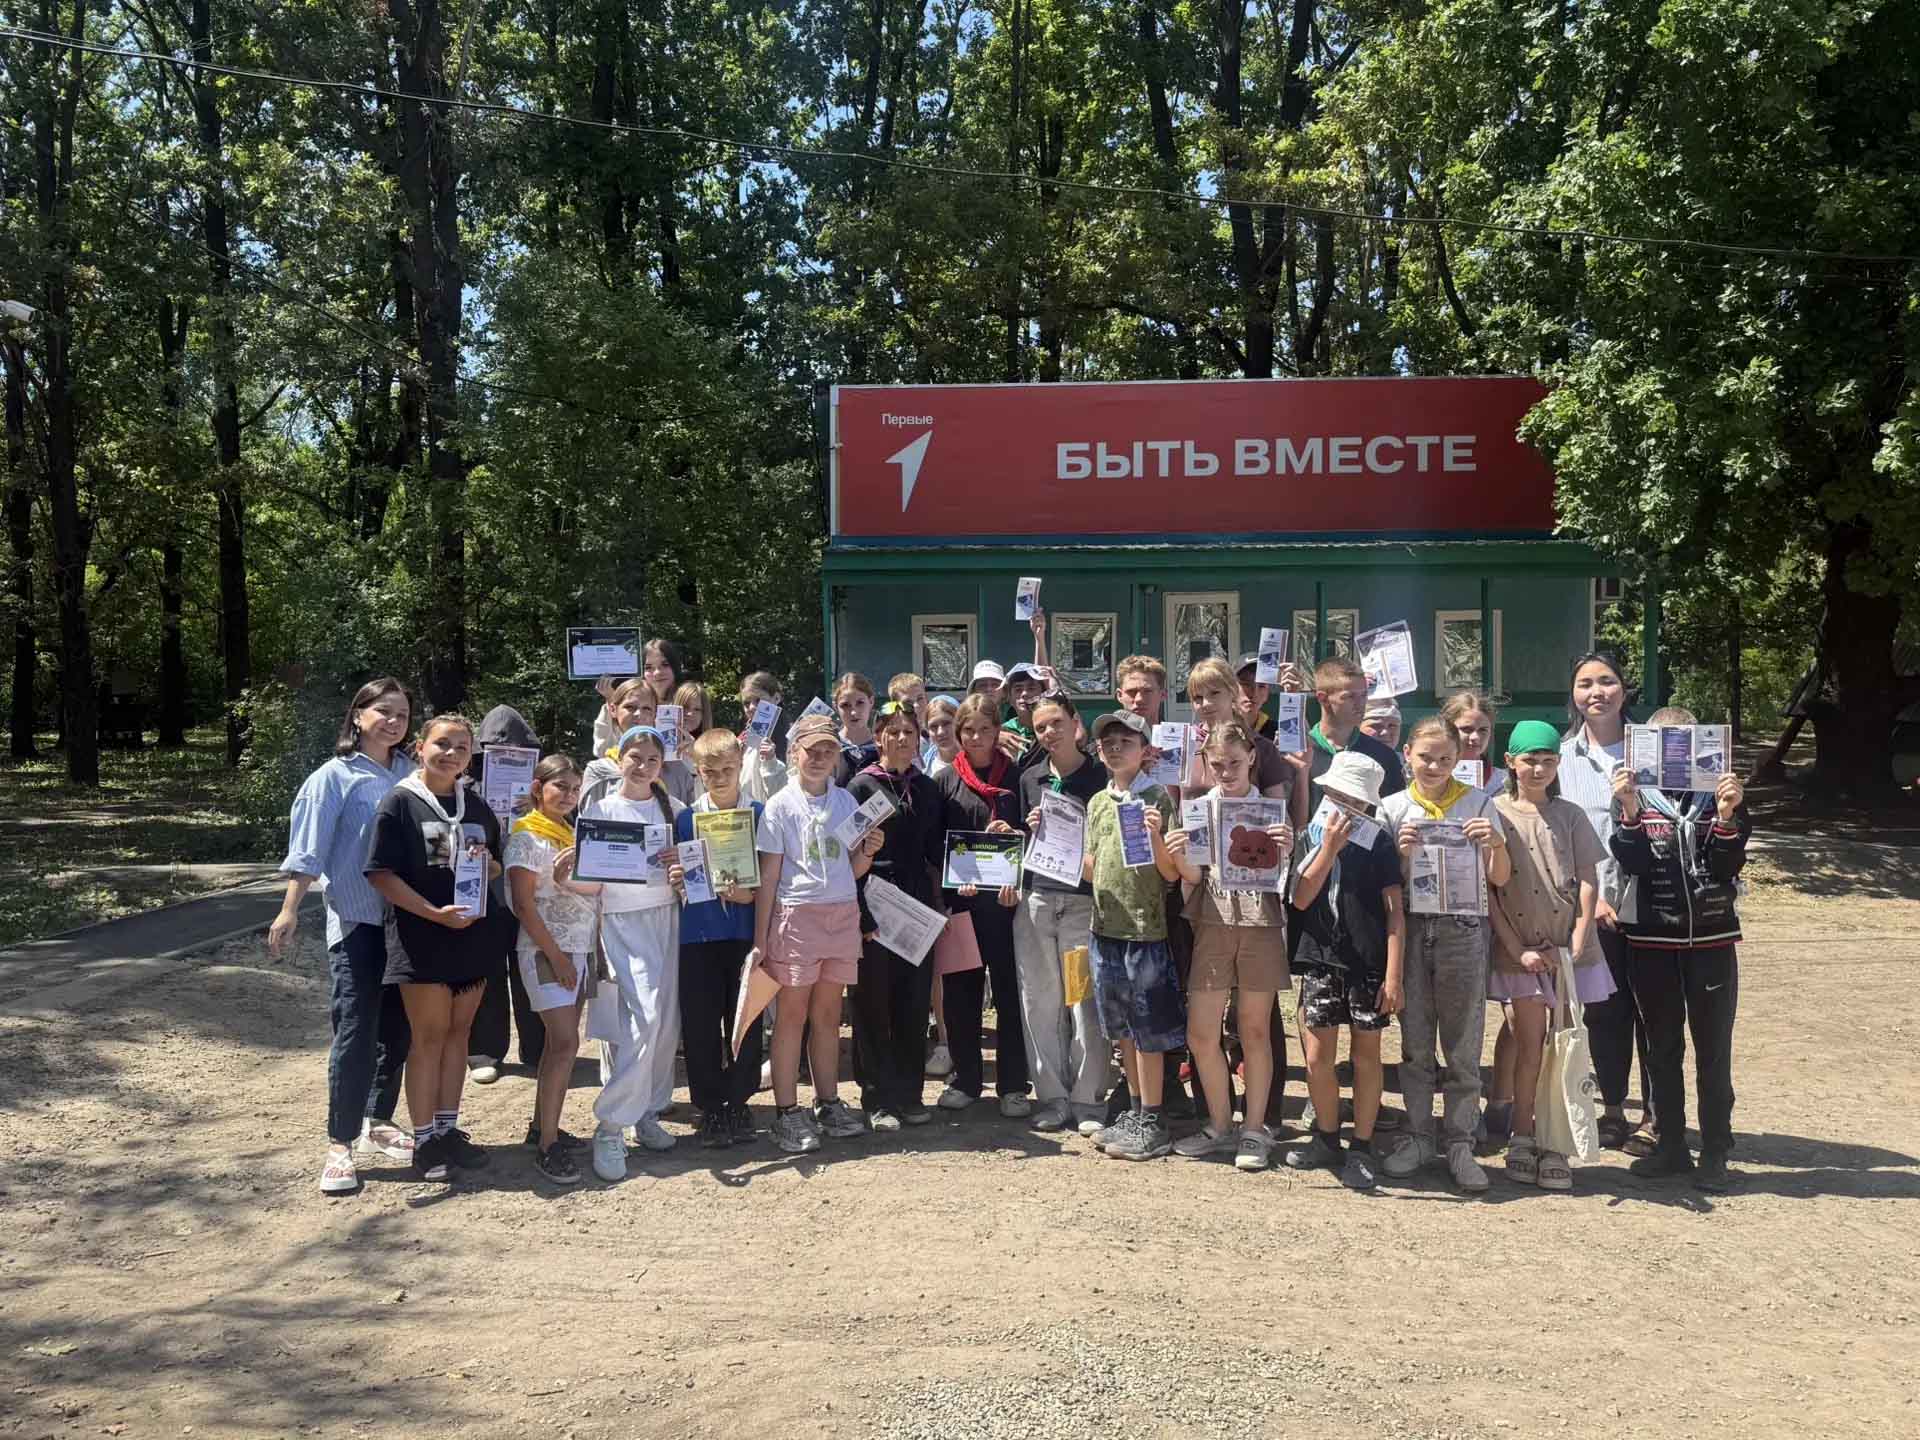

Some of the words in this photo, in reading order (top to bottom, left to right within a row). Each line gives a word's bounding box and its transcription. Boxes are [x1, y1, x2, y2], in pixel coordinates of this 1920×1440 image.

[880, 412, 934, 429] Первые
[1056, 440, 1220, 480] БЫТЬ
[1233, 434, 1478, 476] ВМЕСТЕ
